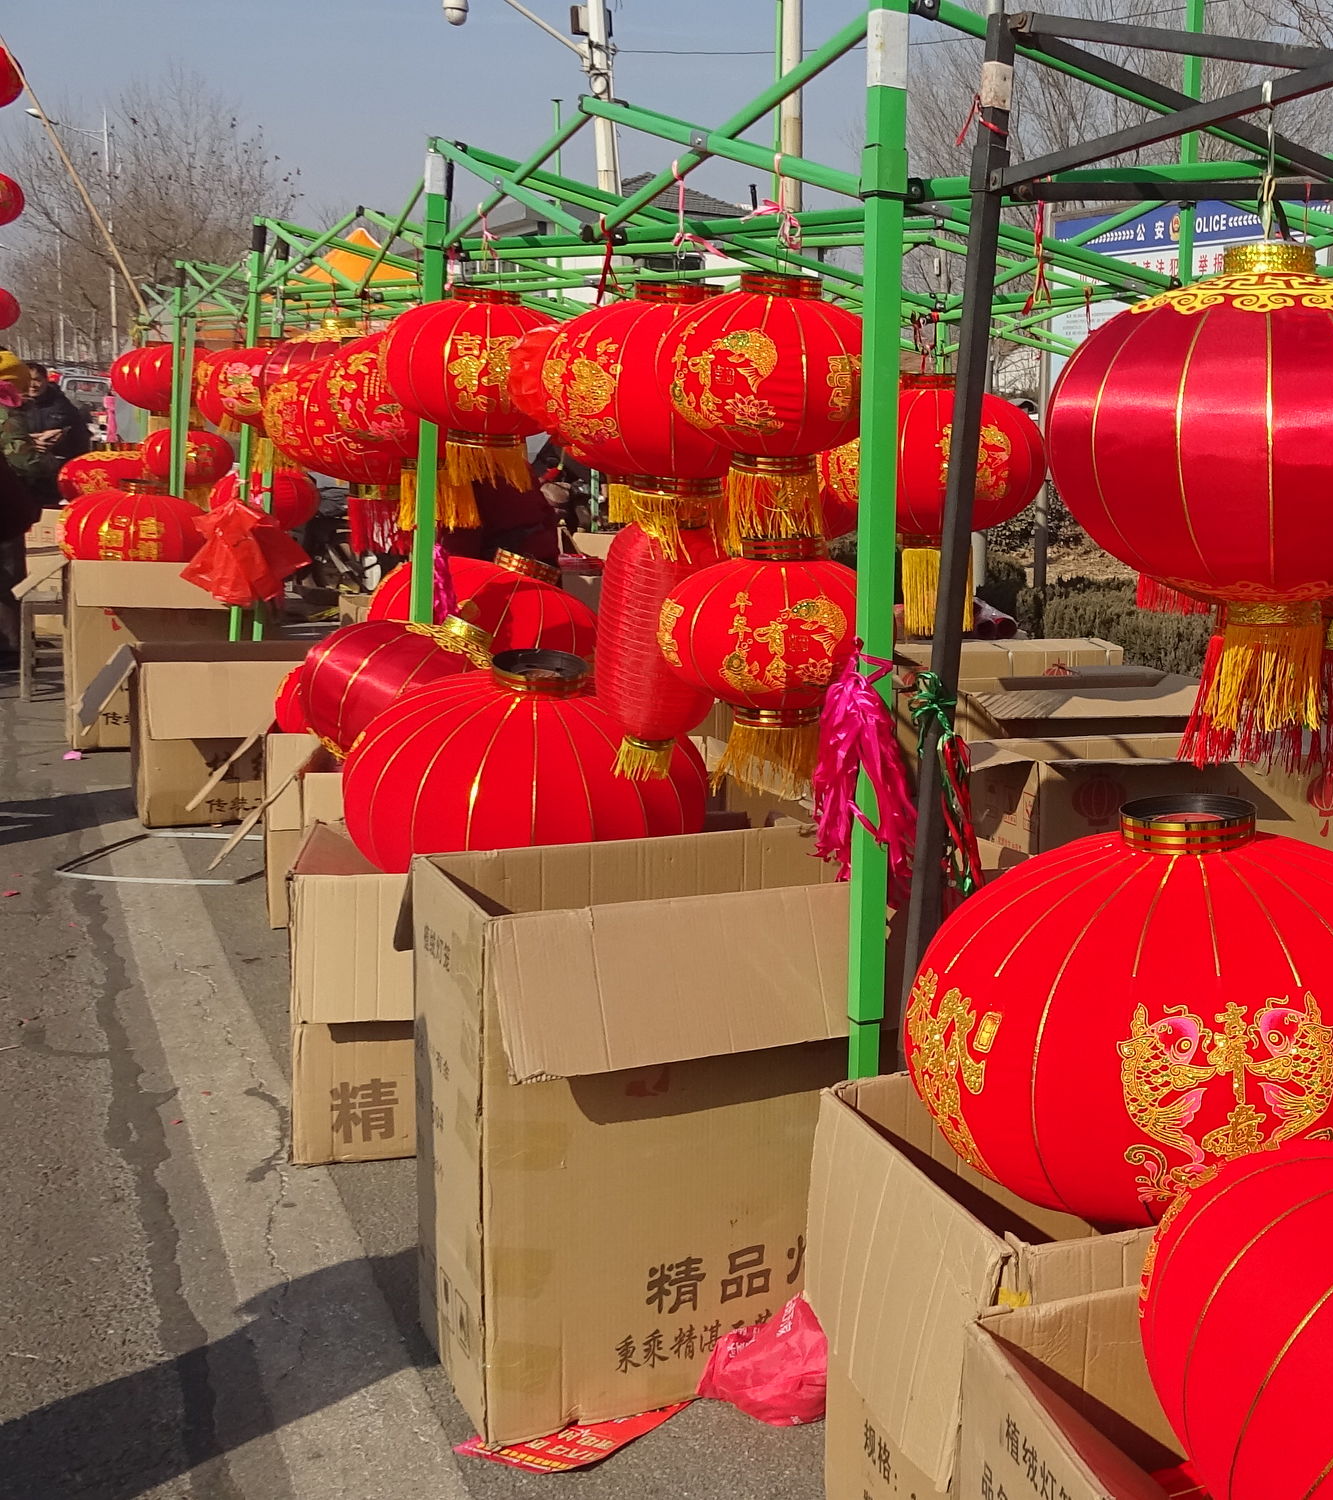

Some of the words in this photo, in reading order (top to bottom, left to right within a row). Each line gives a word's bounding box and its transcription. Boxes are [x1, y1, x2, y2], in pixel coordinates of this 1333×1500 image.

[1137, 220, 1165, 242] 公安
[1195, 214, 1227, 234] OLICE
[329, 1078, 399, 1144] 精
